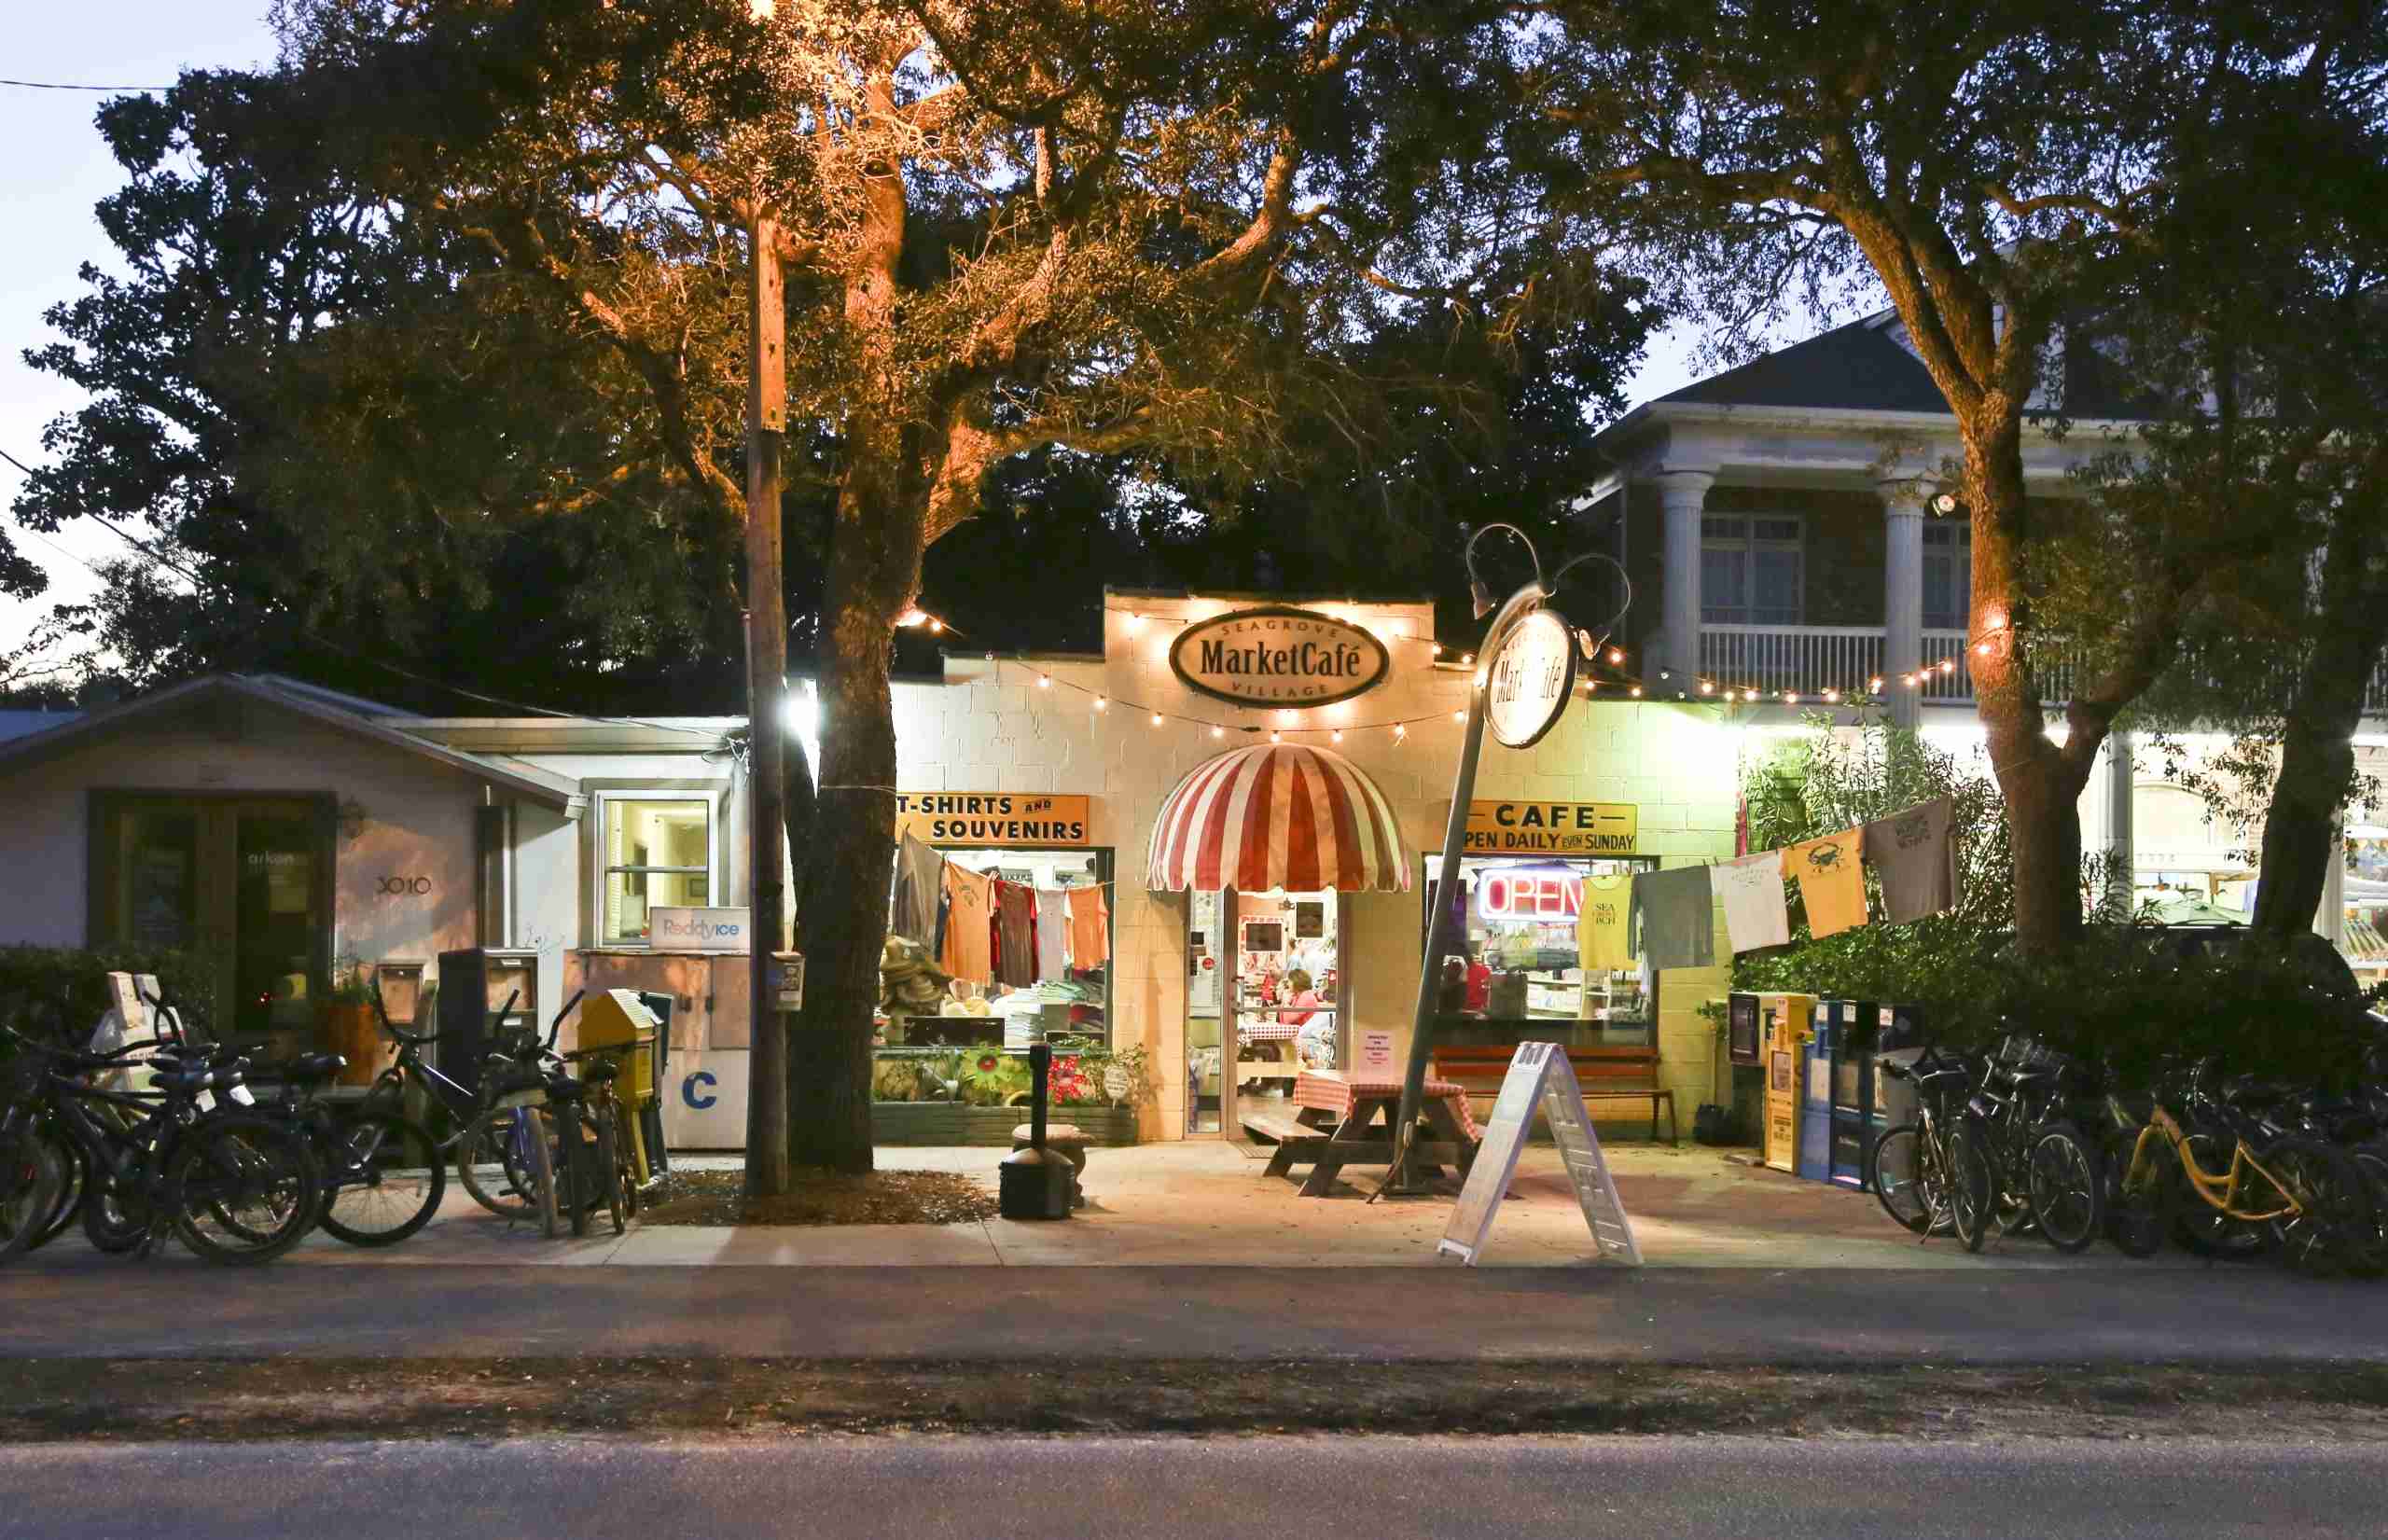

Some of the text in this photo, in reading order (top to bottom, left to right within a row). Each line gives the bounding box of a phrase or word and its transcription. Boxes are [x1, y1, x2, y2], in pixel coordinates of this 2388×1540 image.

[1221, 619, 1339, 638] SEAGROVE
[1201, 640, 1360, 676] MarketCafé
[1231, 682, 1328, 698] VILLAGE
[896, 796, 1052, 814] T-SHIRTS AND
[1495, 804, 1596, 829] CAFE
[933, 820, 1083, 839] SOUVENIRS
[1464, 831, 1634, 851] PEN DAILY EVEN SUNDAY
[375, 877, 432, 895] 3010
[1486, 875, 1585, 916] OPEN
